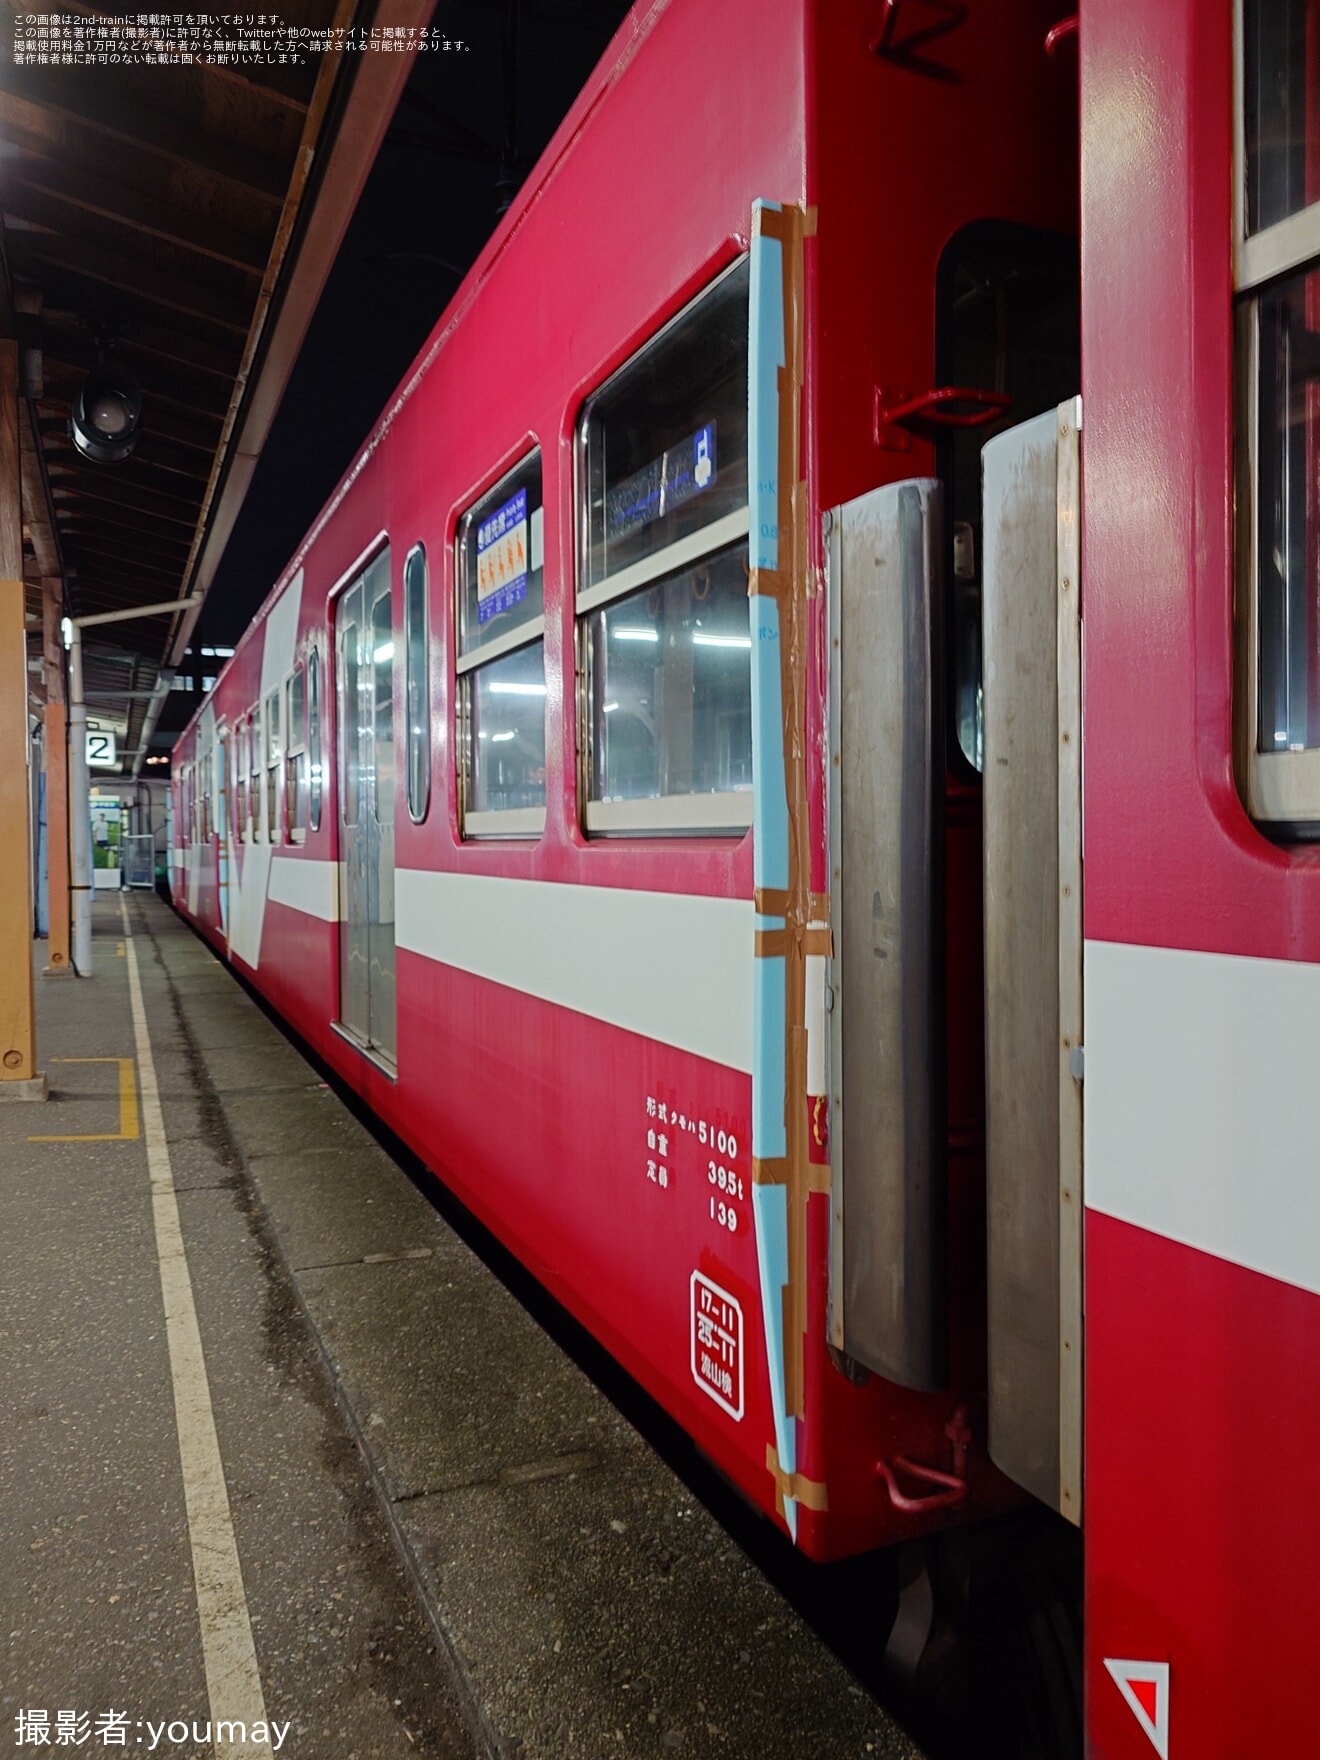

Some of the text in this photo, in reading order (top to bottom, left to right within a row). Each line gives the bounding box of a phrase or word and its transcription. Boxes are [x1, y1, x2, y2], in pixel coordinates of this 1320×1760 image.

[88, 736, 109, 760] 2
[646, 1095, 668, 1125] 形式
[646, 1159, 738, 1232] 定員 139
